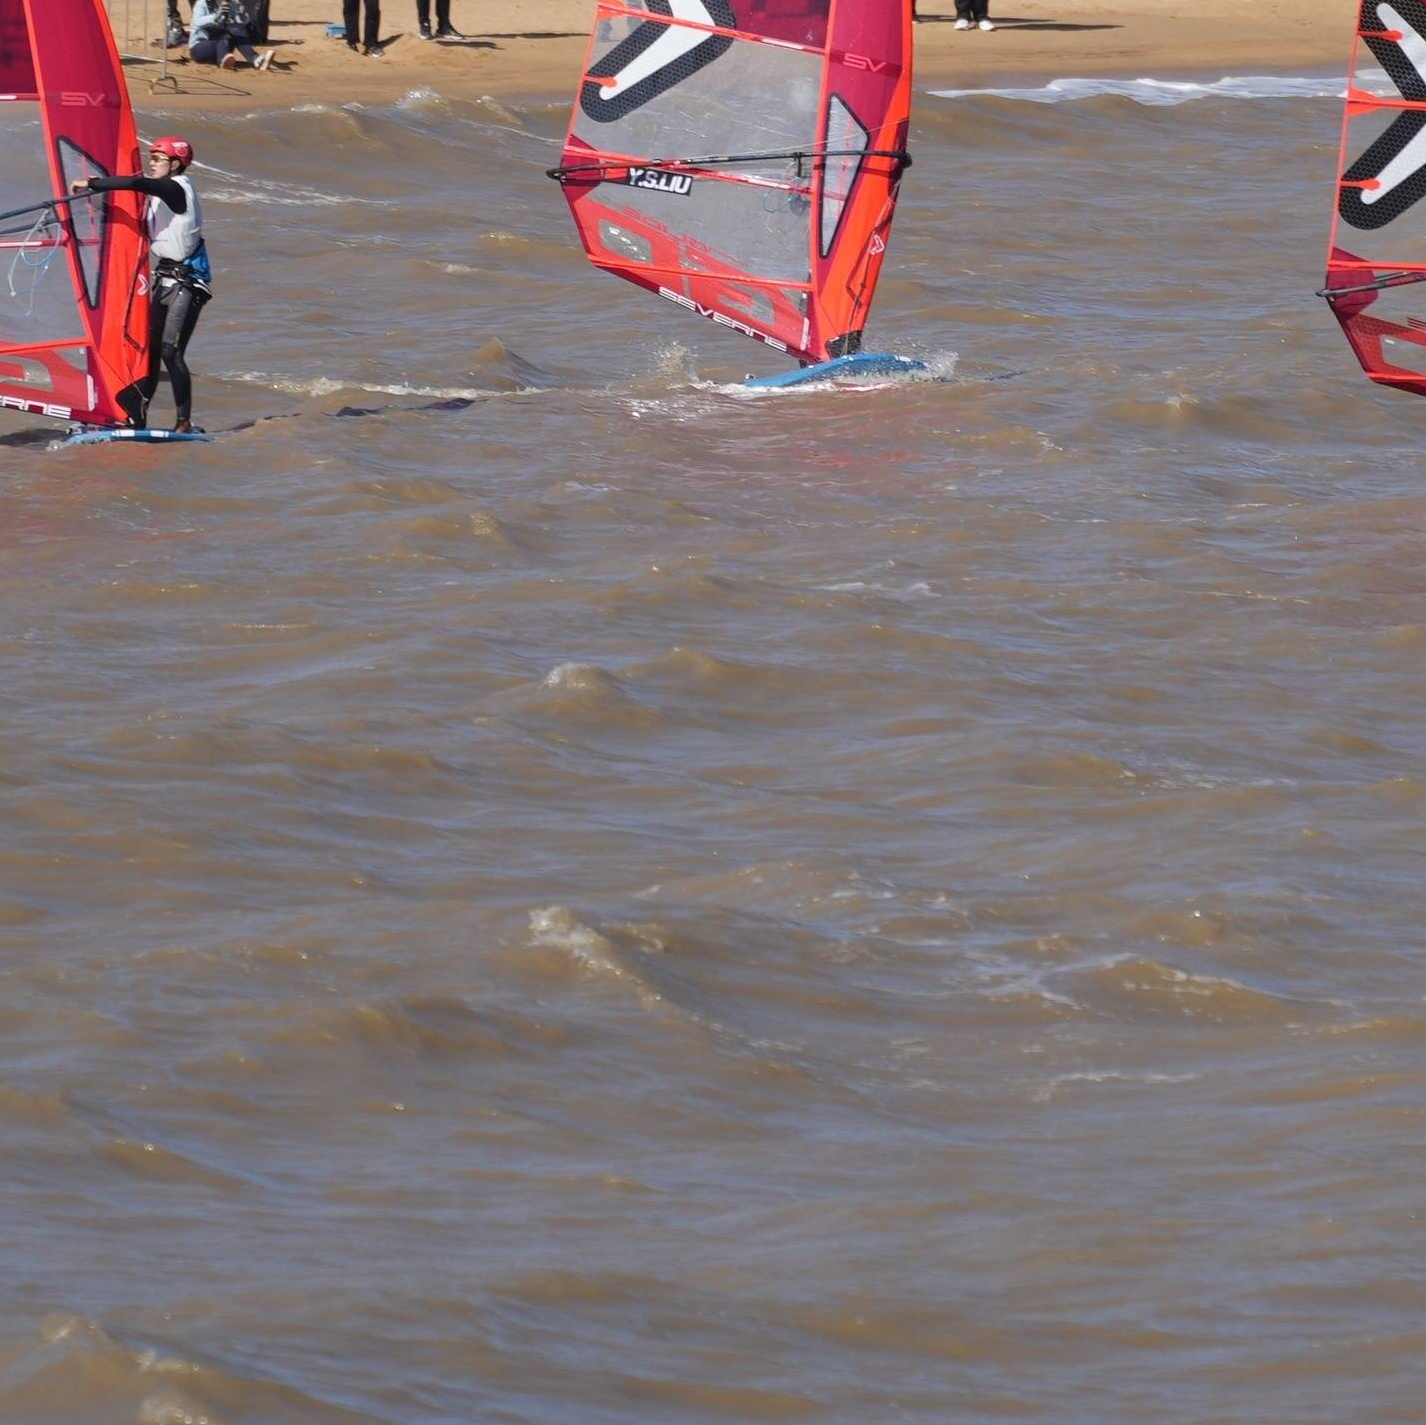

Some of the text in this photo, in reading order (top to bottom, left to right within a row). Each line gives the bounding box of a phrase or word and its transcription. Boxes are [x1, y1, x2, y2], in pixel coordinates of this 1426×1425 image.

[843, 53, 887, 72] SV
[61, 92, 105, 106] SV
[629, 167, 692, 195] Y.S.LIU
[658, 286, 788, 352] SEVERNE
